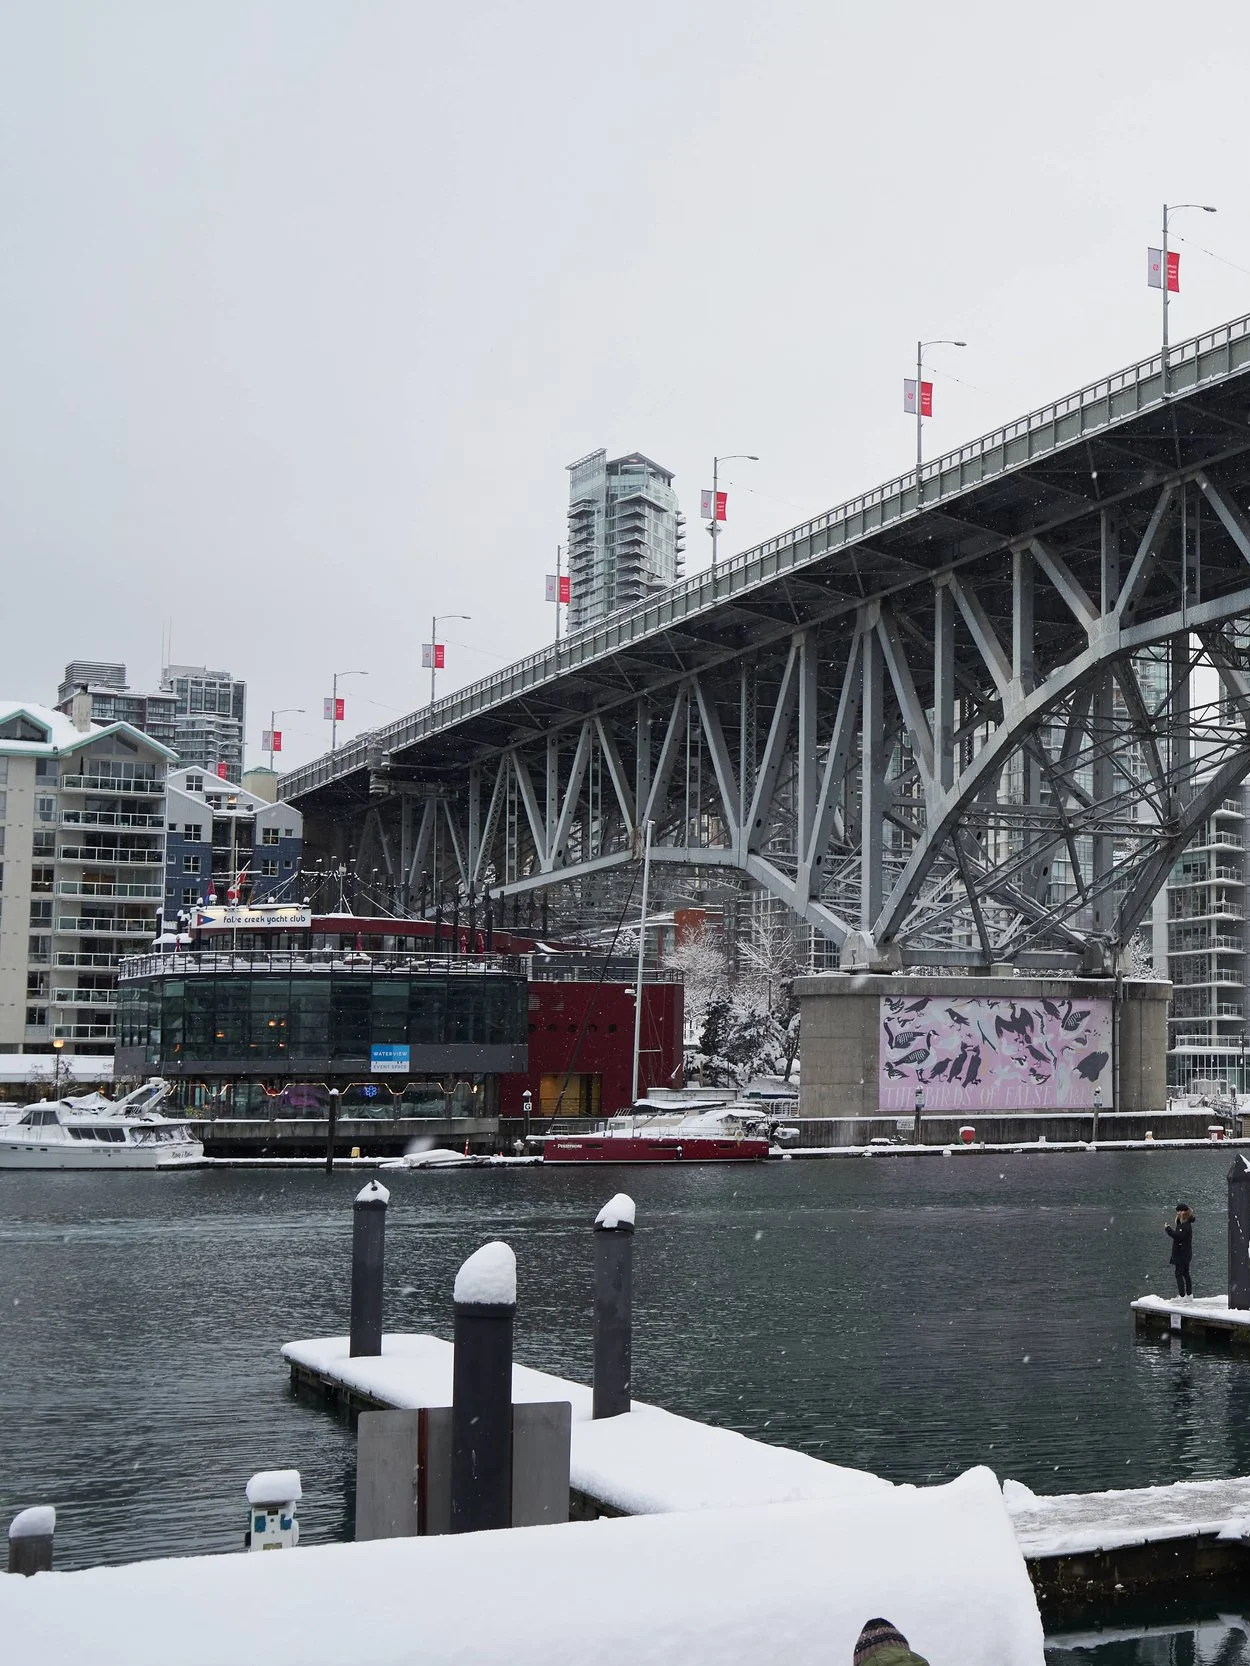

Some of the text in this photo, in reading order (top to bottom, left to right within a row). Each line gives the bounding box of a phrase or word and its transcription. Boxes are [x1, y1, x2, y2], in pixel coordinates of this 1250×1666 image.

[244, 915, 265, 923] creek
[267, 915, 288, 925] yacht
[290, 915, 306, 923] club
[925, 1085, 973, 1107] BIRDS
[979, 1085, 1000, 1106] OF
[1005, 1085, 1052, 1107] FALSE
